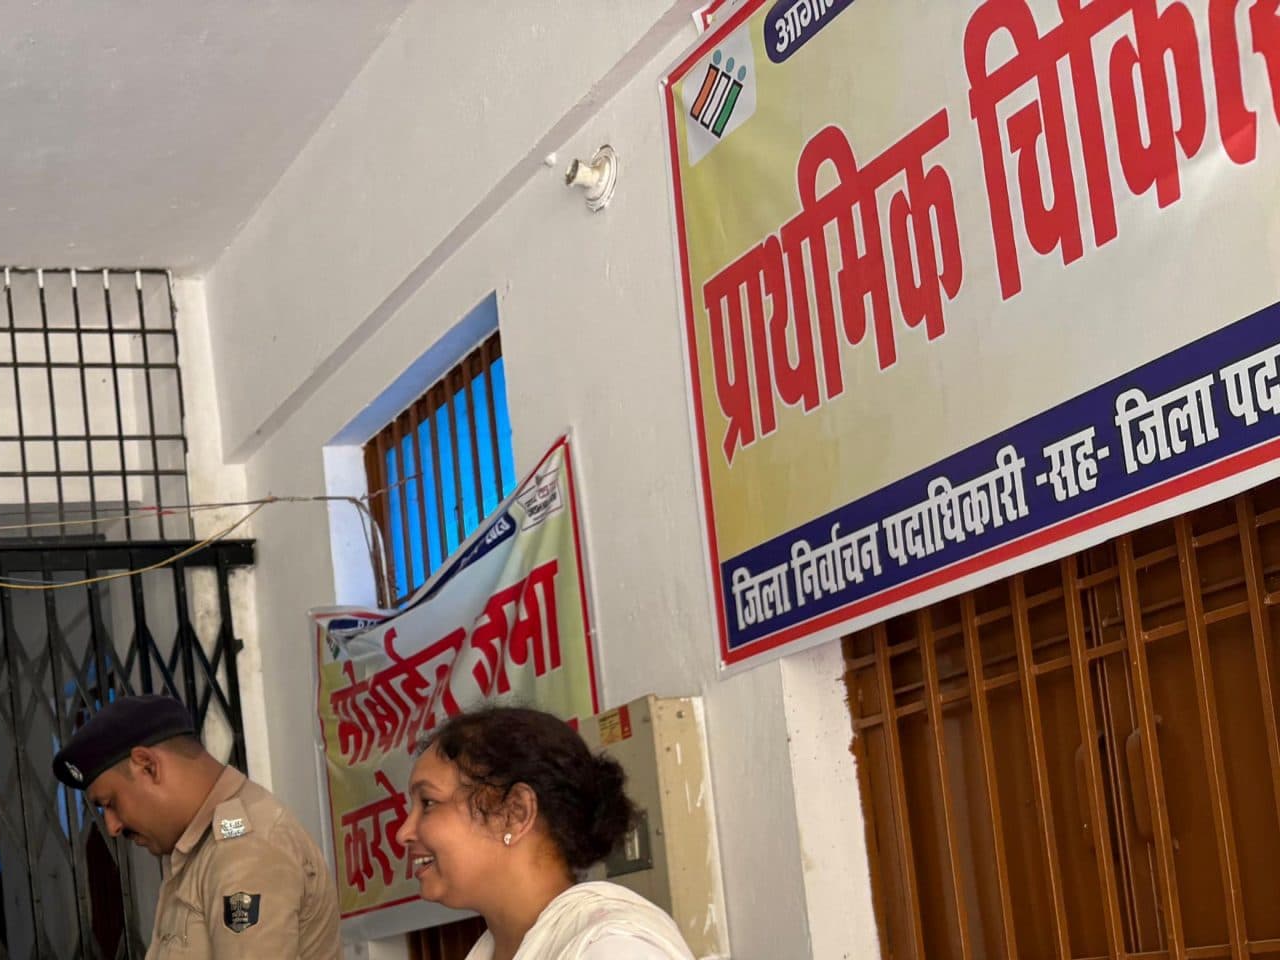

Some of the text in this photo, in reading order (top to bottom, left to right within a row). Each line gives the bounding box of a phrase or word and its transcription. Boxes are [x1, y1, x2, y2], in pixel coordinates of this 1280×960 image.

[703, 108, 963, 465] प्राथमिक
[471, 560, 562, 698] जमा
[732, 567, 790, 631] जिला
[791, 522, 882, 608] निर्वाचन
[882, 444, 1030, 566] पदाधिकारी
[1115, 388, 1220, 475] जिला
